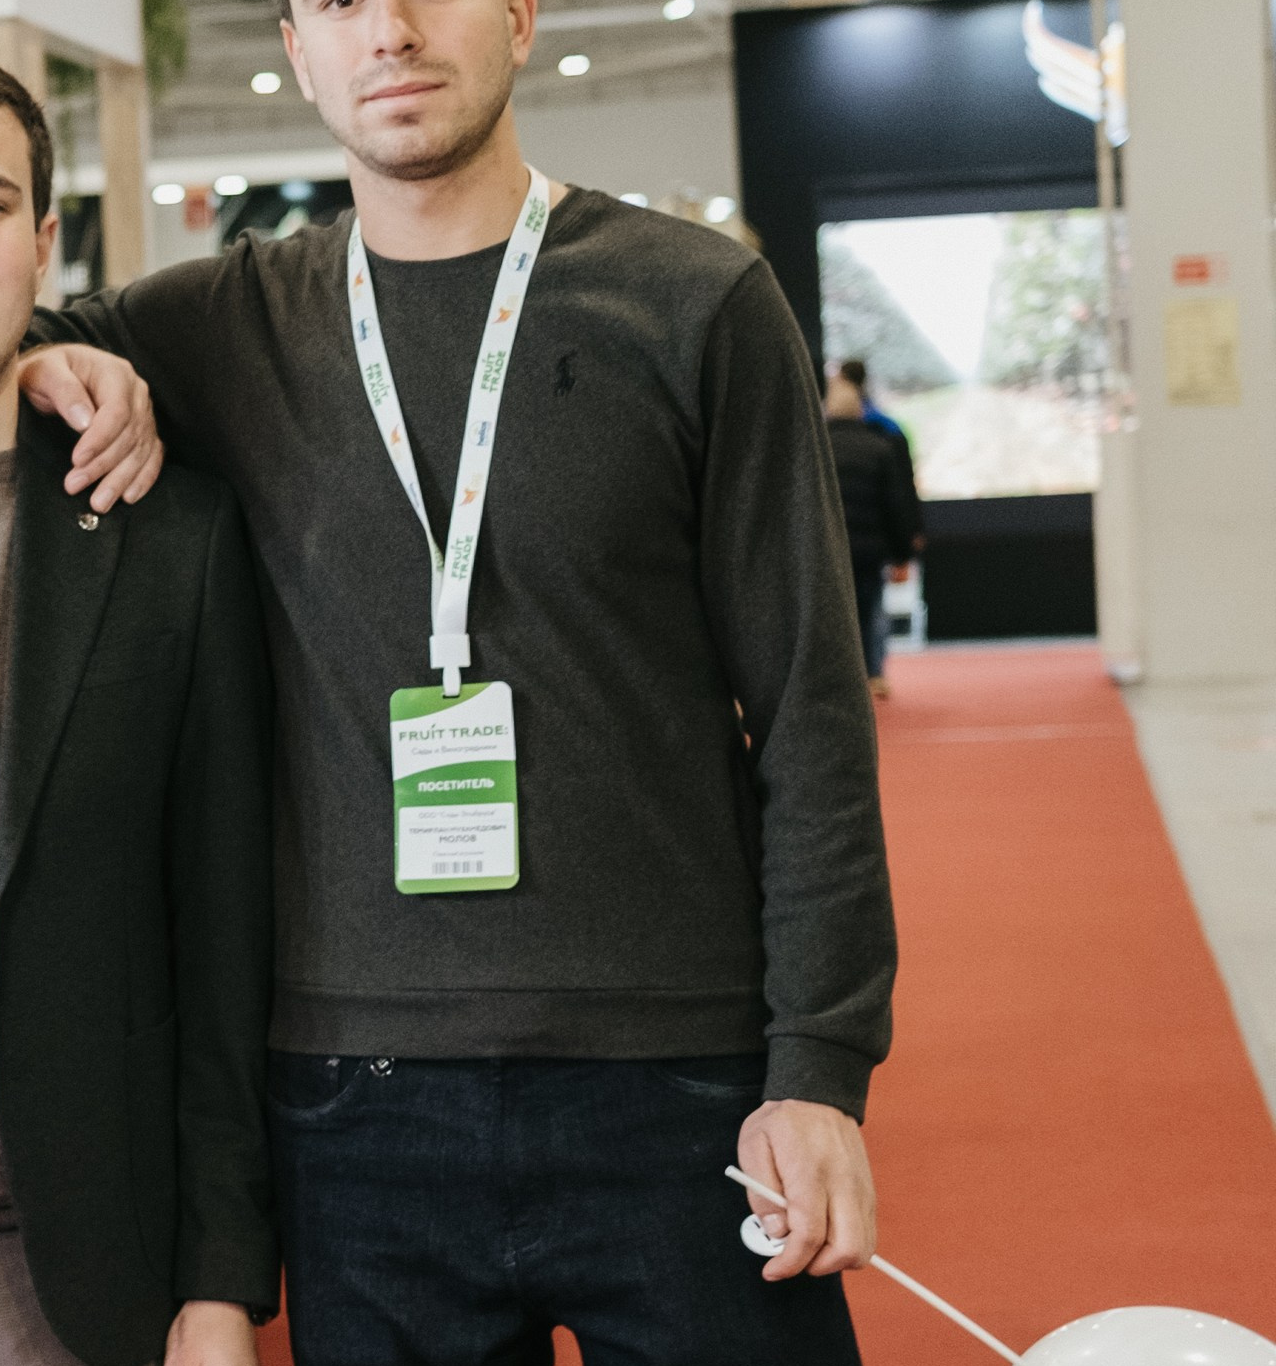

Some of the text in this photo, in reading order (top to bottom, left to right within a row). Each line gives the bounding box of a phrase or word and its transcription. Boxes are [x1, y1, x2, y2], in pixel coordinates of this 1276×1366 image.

[489, 351, 506, 393] TRADE
[459, 535, 474, 581] TRADE
[418, 778, 495, 792] ПОСЕТИТЕЛЬ
